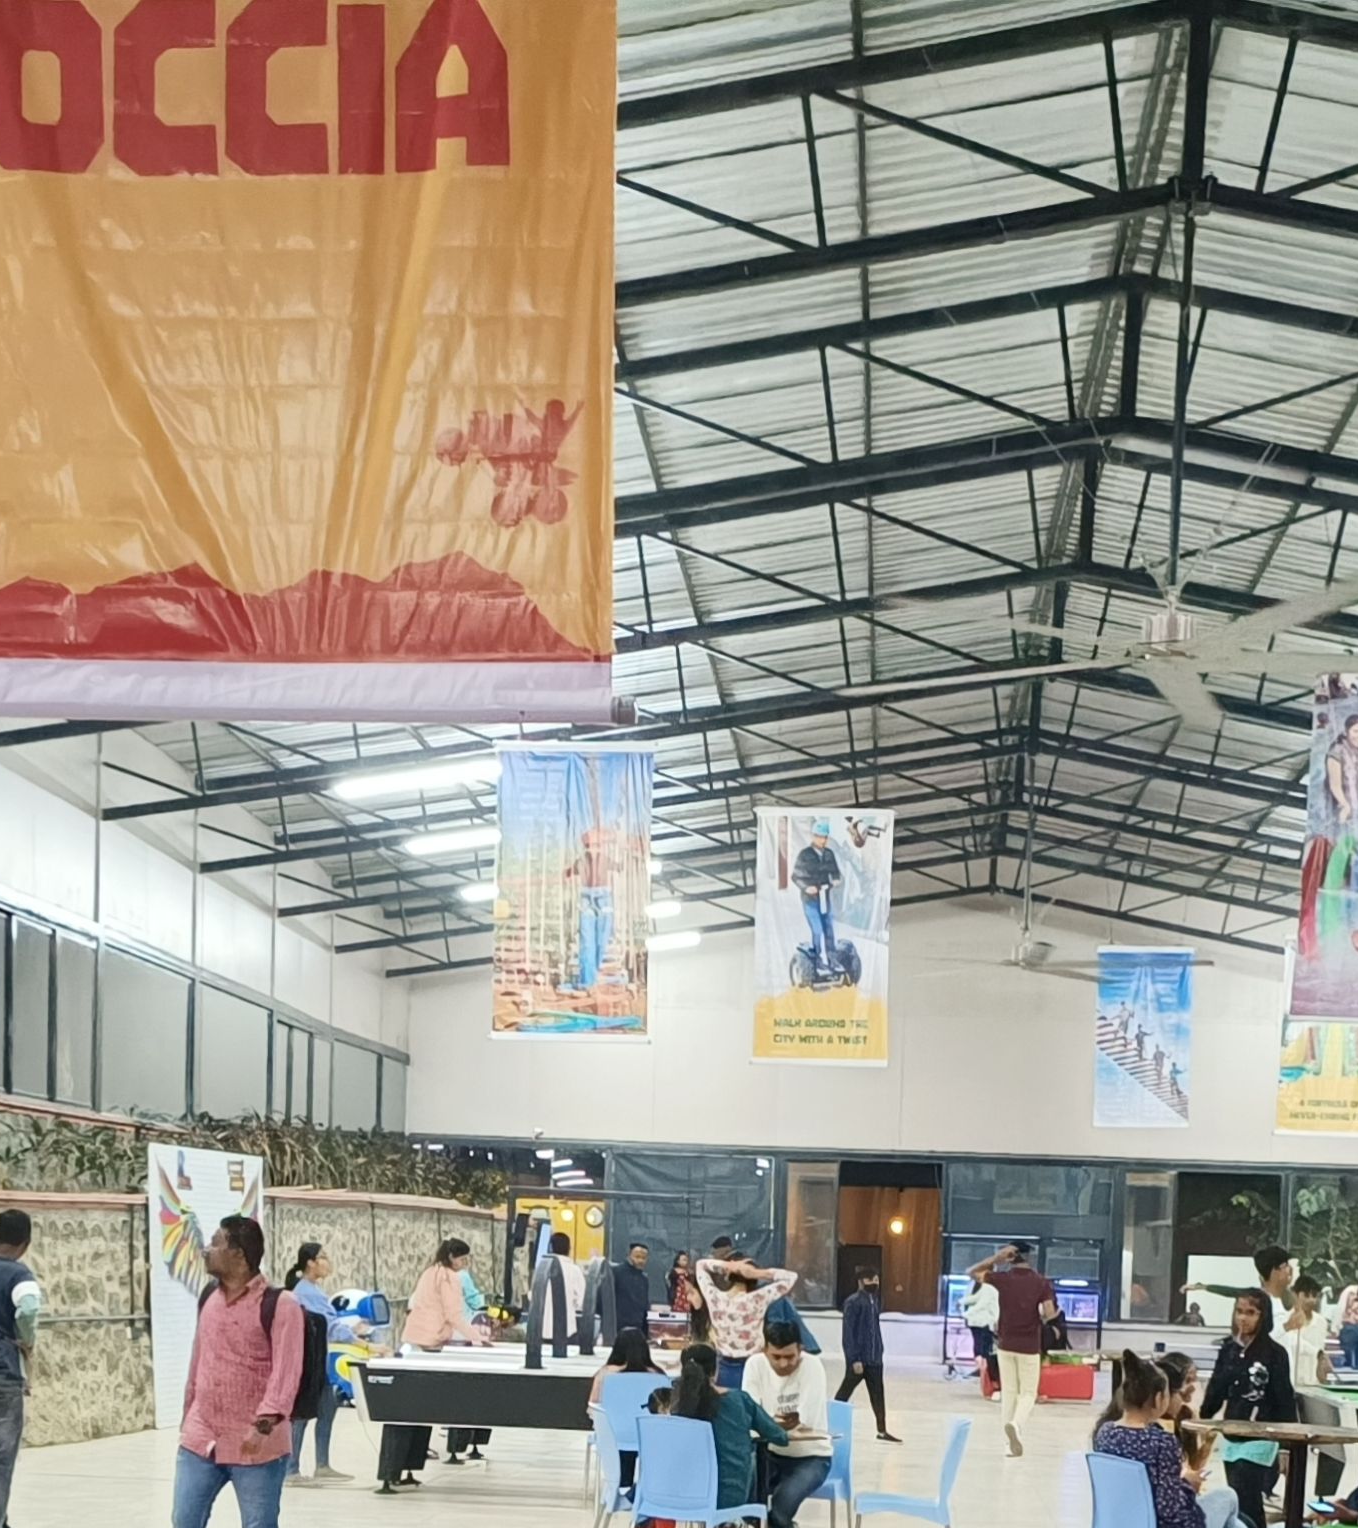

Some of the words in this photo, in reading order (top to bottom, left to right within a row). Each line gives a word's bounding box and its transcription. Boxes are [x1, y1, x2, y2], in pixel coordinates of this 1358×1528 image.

[773, 1018, 801, 1028] WALK
[804, 1018, 846, 1029] AROUND
[773, 1033, 795, 1044] CITY
[799, 1034, 823, 1044] WITH
[826, 1034, 834, 1044] A
[837, 1034, 867, 1045] TWIST
